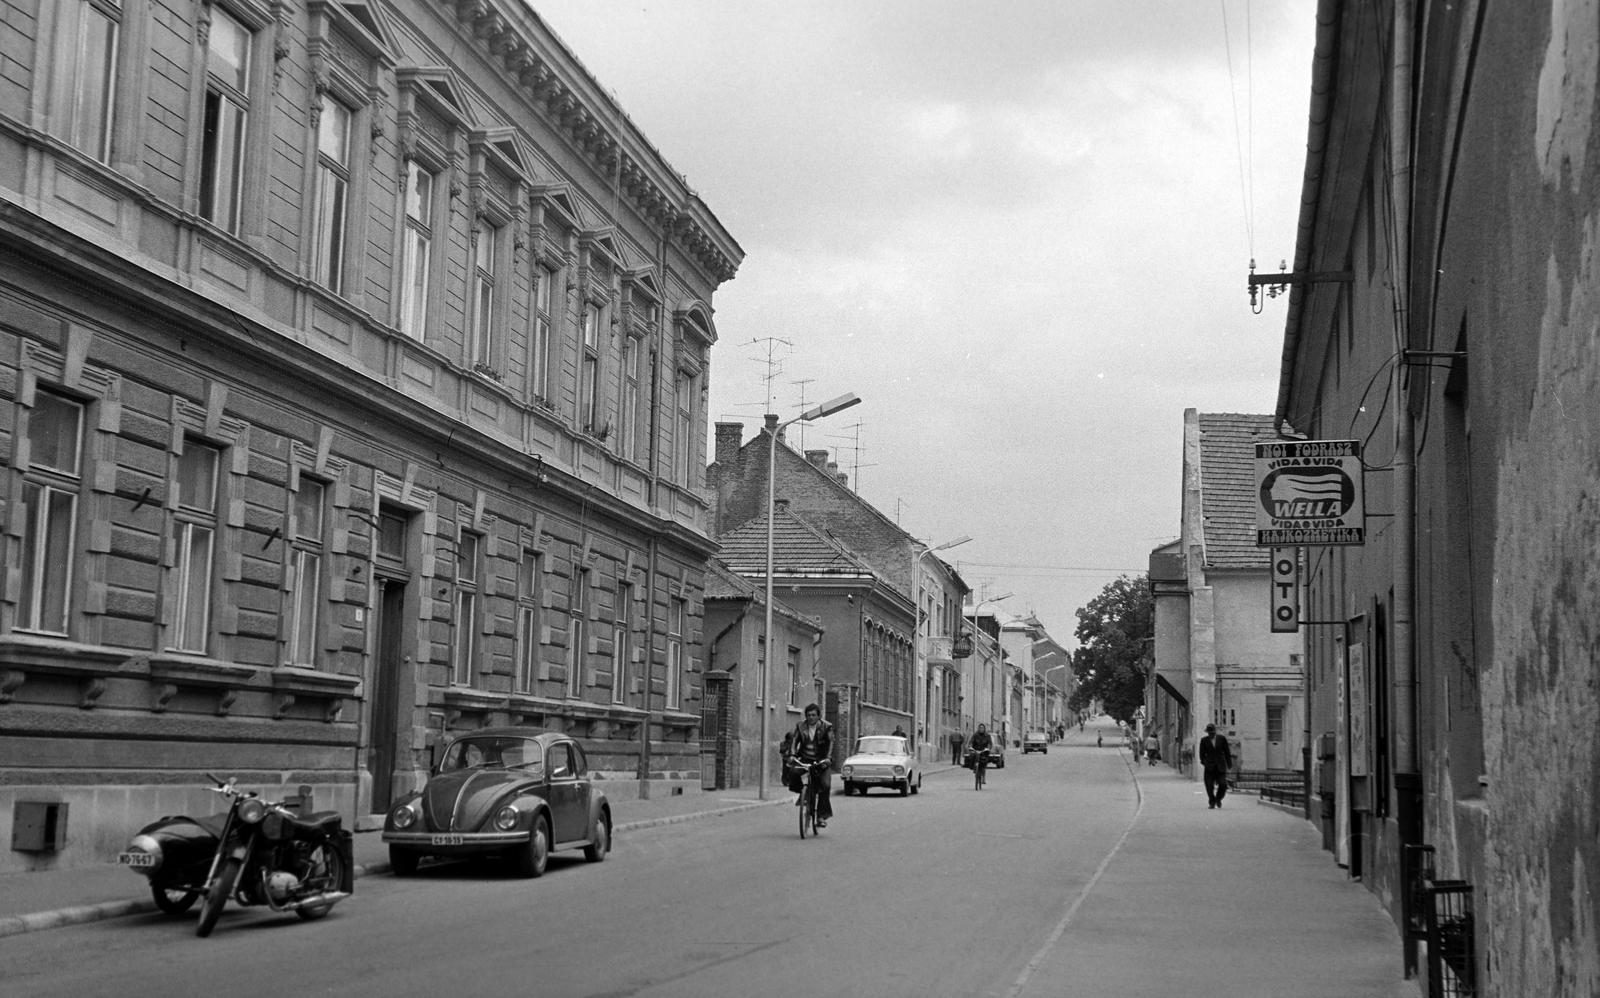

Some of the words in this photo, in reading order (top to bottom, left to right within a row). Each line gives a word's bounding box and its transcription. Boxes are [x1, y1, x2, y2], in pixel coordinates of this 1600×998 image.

[1268, 458, 1301, 470] VIDA
[1312, 457, 1343, 468] VIDA
[1274, 501, 1342, 517] WELLA
[1271, 518, 1302, 529] VIDA
[1312, 518, 1345, 529] VIDA
[1276, 547, 1293, 622] OTO
